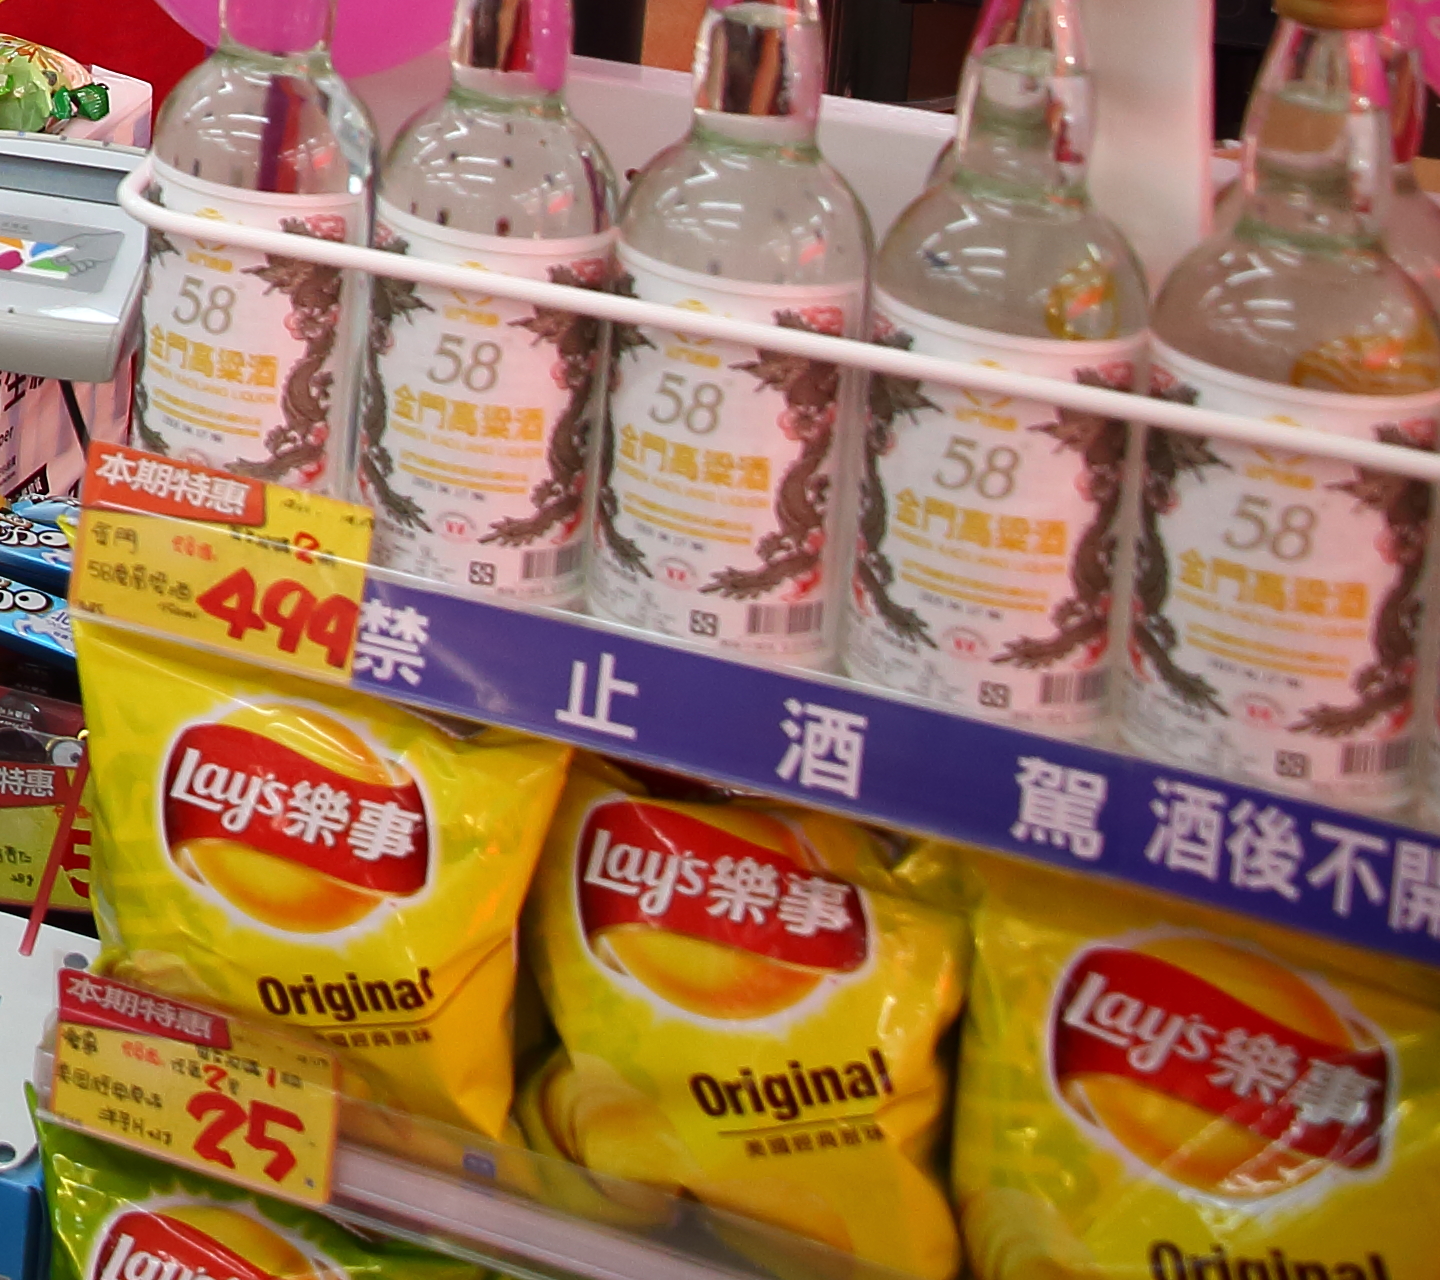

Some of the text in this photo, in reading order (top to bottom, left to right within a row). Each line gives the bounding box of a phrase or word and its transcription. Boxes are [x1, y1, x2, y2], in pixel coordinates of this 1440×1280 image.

[173, 276, 234, 333] 58
[429, 332, 503, 391] 58
[649, 372, 726, 433] 58
[95, 452, 250, 515] 本期特惠
[934, 436, 1020, 499] 58
[1221, 496, 1318, 561] 58
[196, 567, 362, 668] 499
[65, 978, 212, 1040] 本期特惠
[690, 1050, 893, 1121] Original
[185, 1092, 305, 1182] 25
